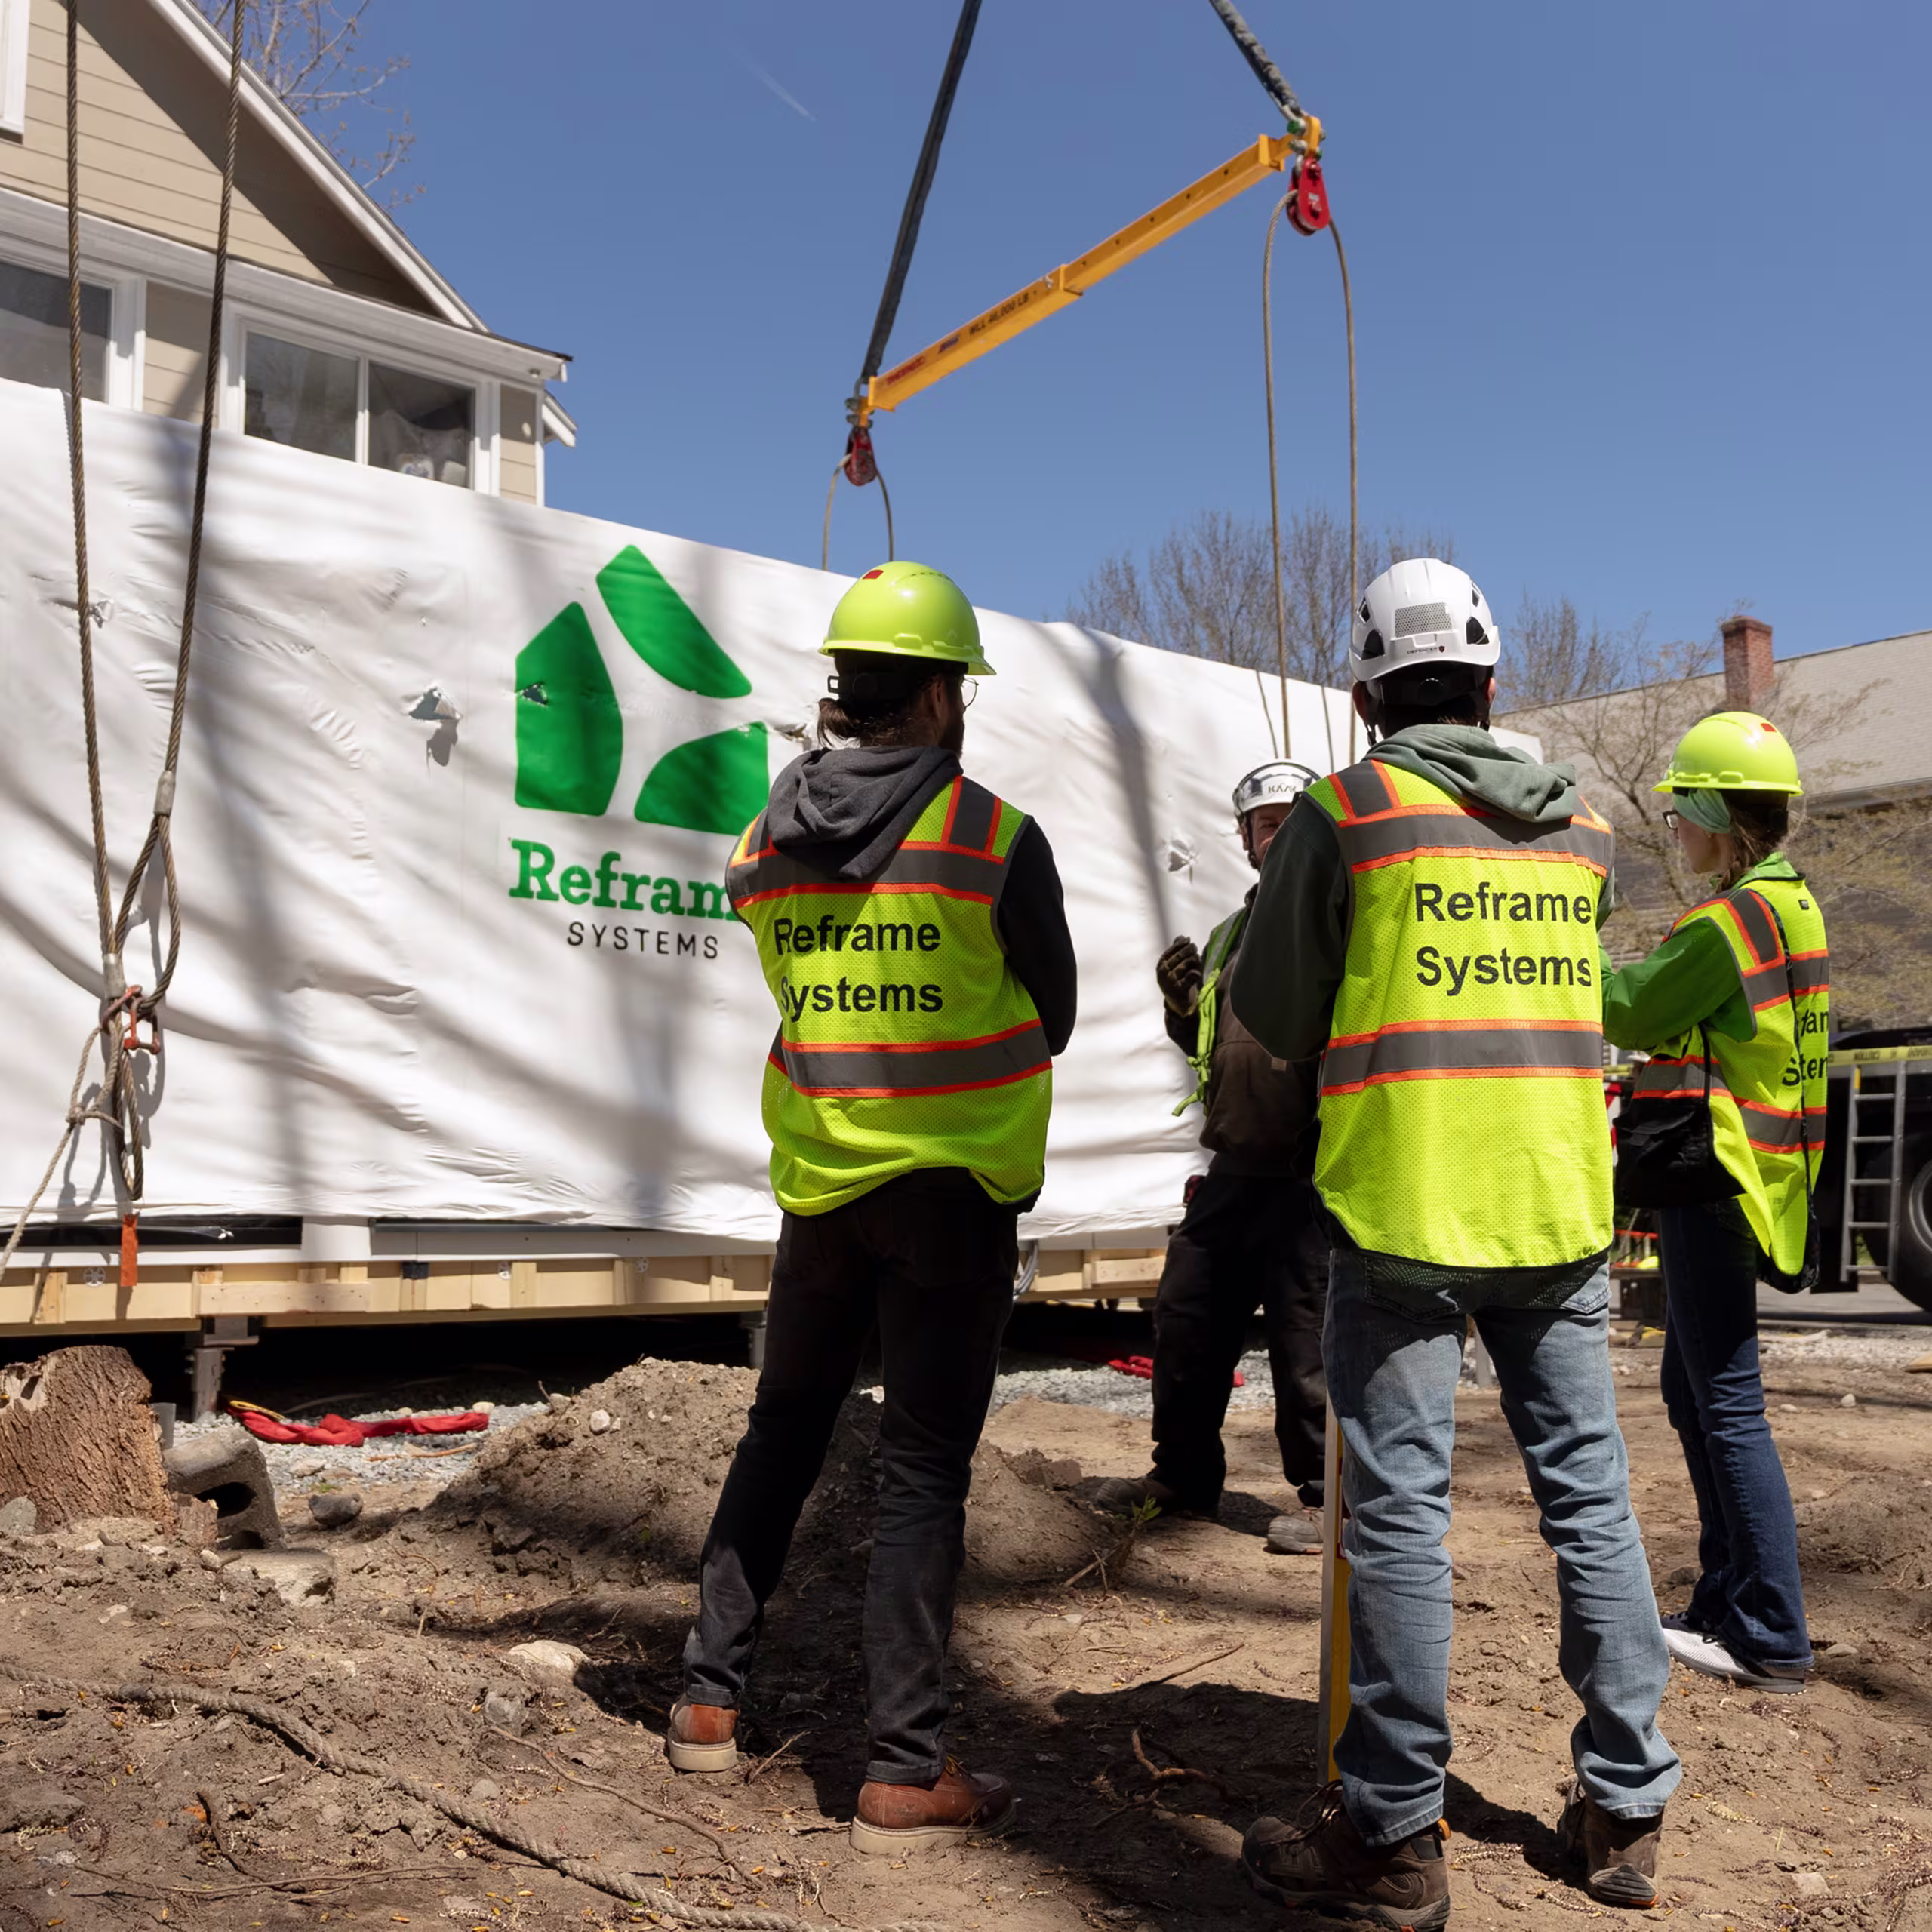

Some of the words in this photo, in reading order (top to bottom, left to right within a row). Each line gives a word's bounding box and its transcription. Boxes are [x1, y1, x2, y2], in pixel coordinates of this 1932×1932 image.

[508, 838, 740, 921] Refram
[1414, 881, 1592, 924] Reframe
[567, 921, 718, 959] SYSTEMS
[774, 914, 941, 955] Reframe
[1416, 946, 1592, 996] Systems
[781, 976, 943, 1023] Systems
